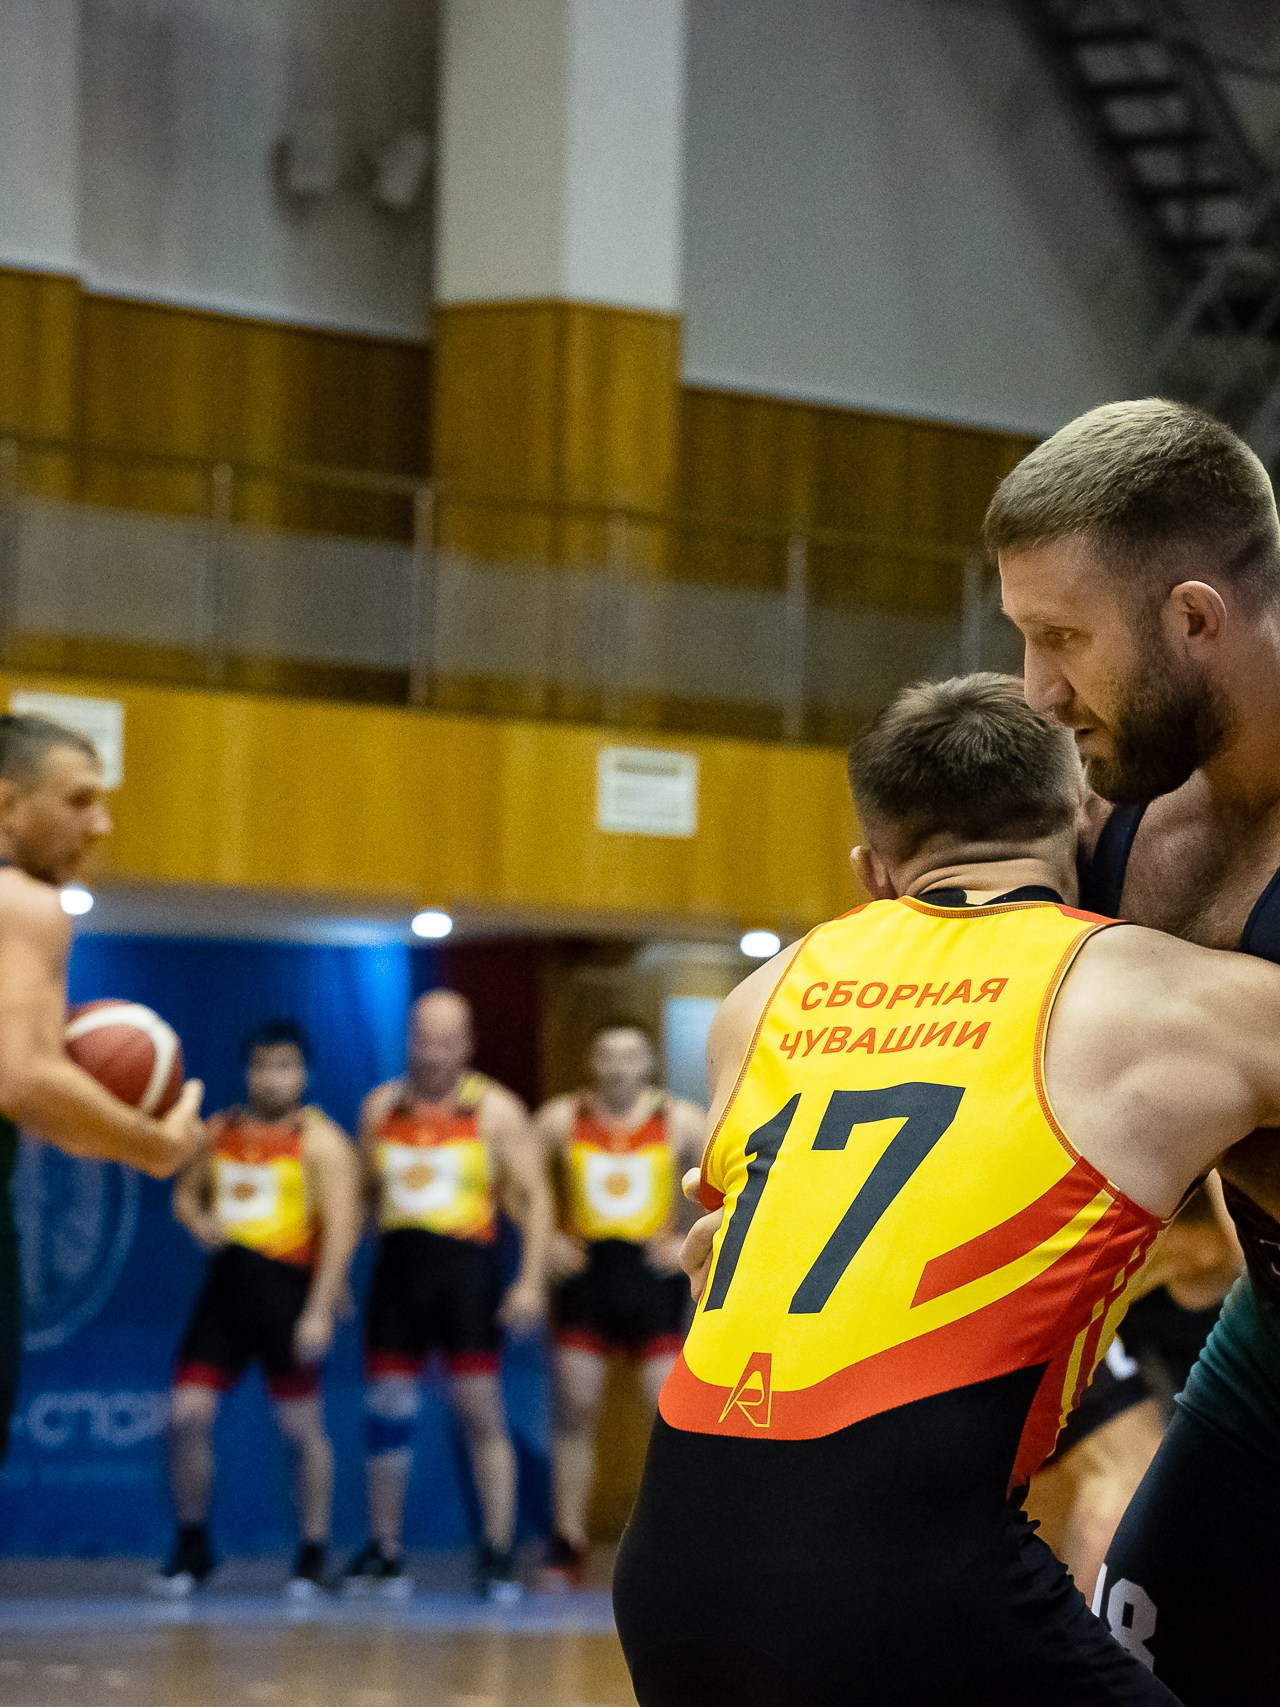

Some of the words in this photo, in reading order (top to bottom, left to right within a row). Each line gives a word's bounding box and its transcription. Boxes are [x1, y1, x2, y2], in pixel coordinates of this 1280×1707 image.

[801, 977, 1009, 1011] СБОРНАЯ
[779, 1020, 992, 1060] ЧУВАШИИ
[703, 1082, 966, 1315] 17
